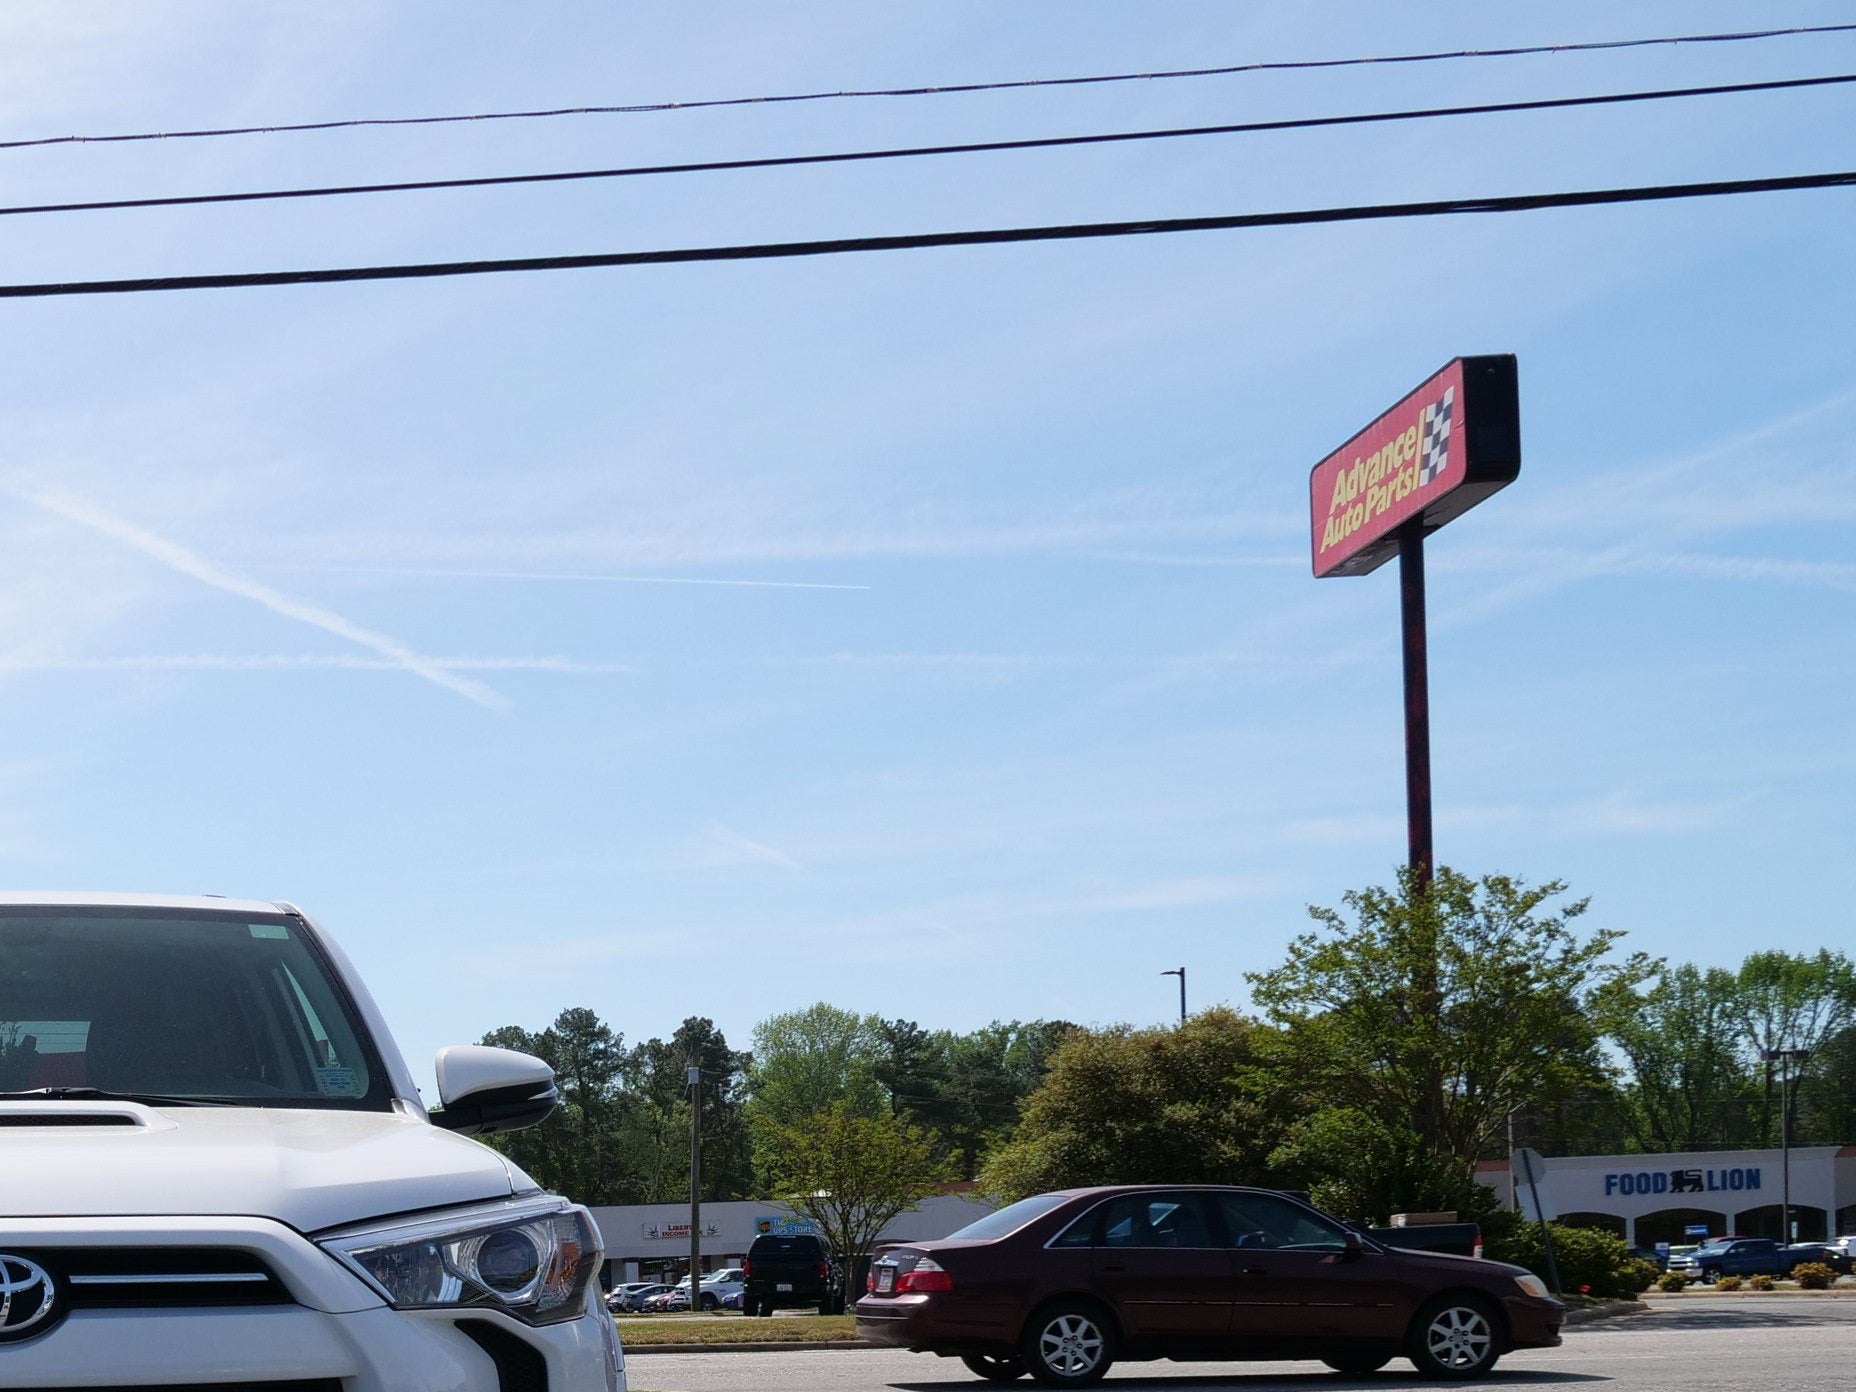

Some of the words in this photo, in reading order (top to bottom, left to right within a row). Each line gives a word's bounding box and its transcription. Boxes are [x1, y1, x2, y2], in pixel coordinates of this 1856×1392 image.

[1328, 425, 1418, 515] Advance
[1319, 508, 1366, 554] Auto
[1363, 466, 1414, 525] Parts
[1604, 1172, 1668, 1196] FOOD
[1707, 1168, 1762, 1192] LION
[773, 1226, 788, 1234] UPS
